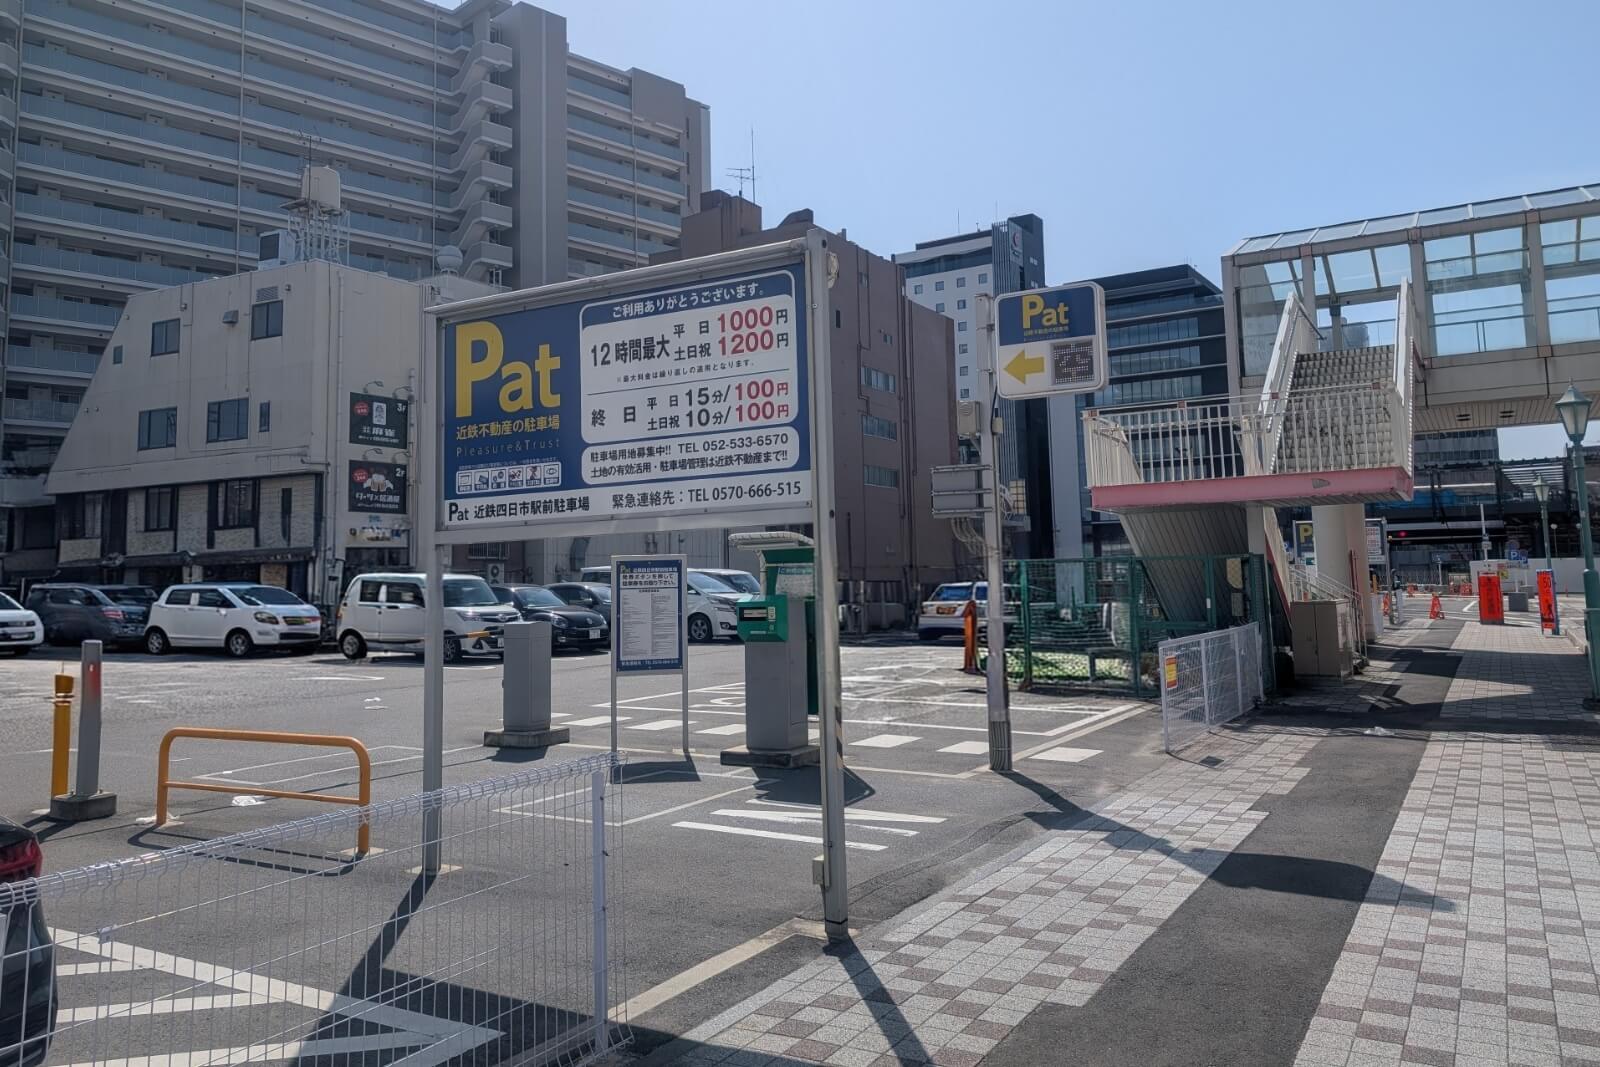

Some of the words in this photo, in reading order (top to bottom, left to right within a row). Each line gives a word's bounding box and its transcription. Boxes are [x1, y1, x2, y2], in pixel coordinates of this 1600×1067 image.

[612, 282, 764, 318] ご利用ありがとうございます。
[1022, 294, 1069, 329] Pat
[717, 306, 788, 333] 1000円
[590, 334, 671, 367] 12時間最大
[673, 343, 712, 362] 土日祝
[718, 329, 789, 357] 1200円
[455, 320, 561, 418] Pat
[456, 415, 560, 441] 近鉄不動産の駐車場
[647, 415, 680, 432] 土日祝
[678, 442, 700, 454] TEL
[702, 432, 789, 452] 052-533-6570
[712, 481, 801, 501] 0570-666-515
[448, 502, 469, 522] Pat
[473, 496, 590, 519] 近鉄四日市駅前駐車場
